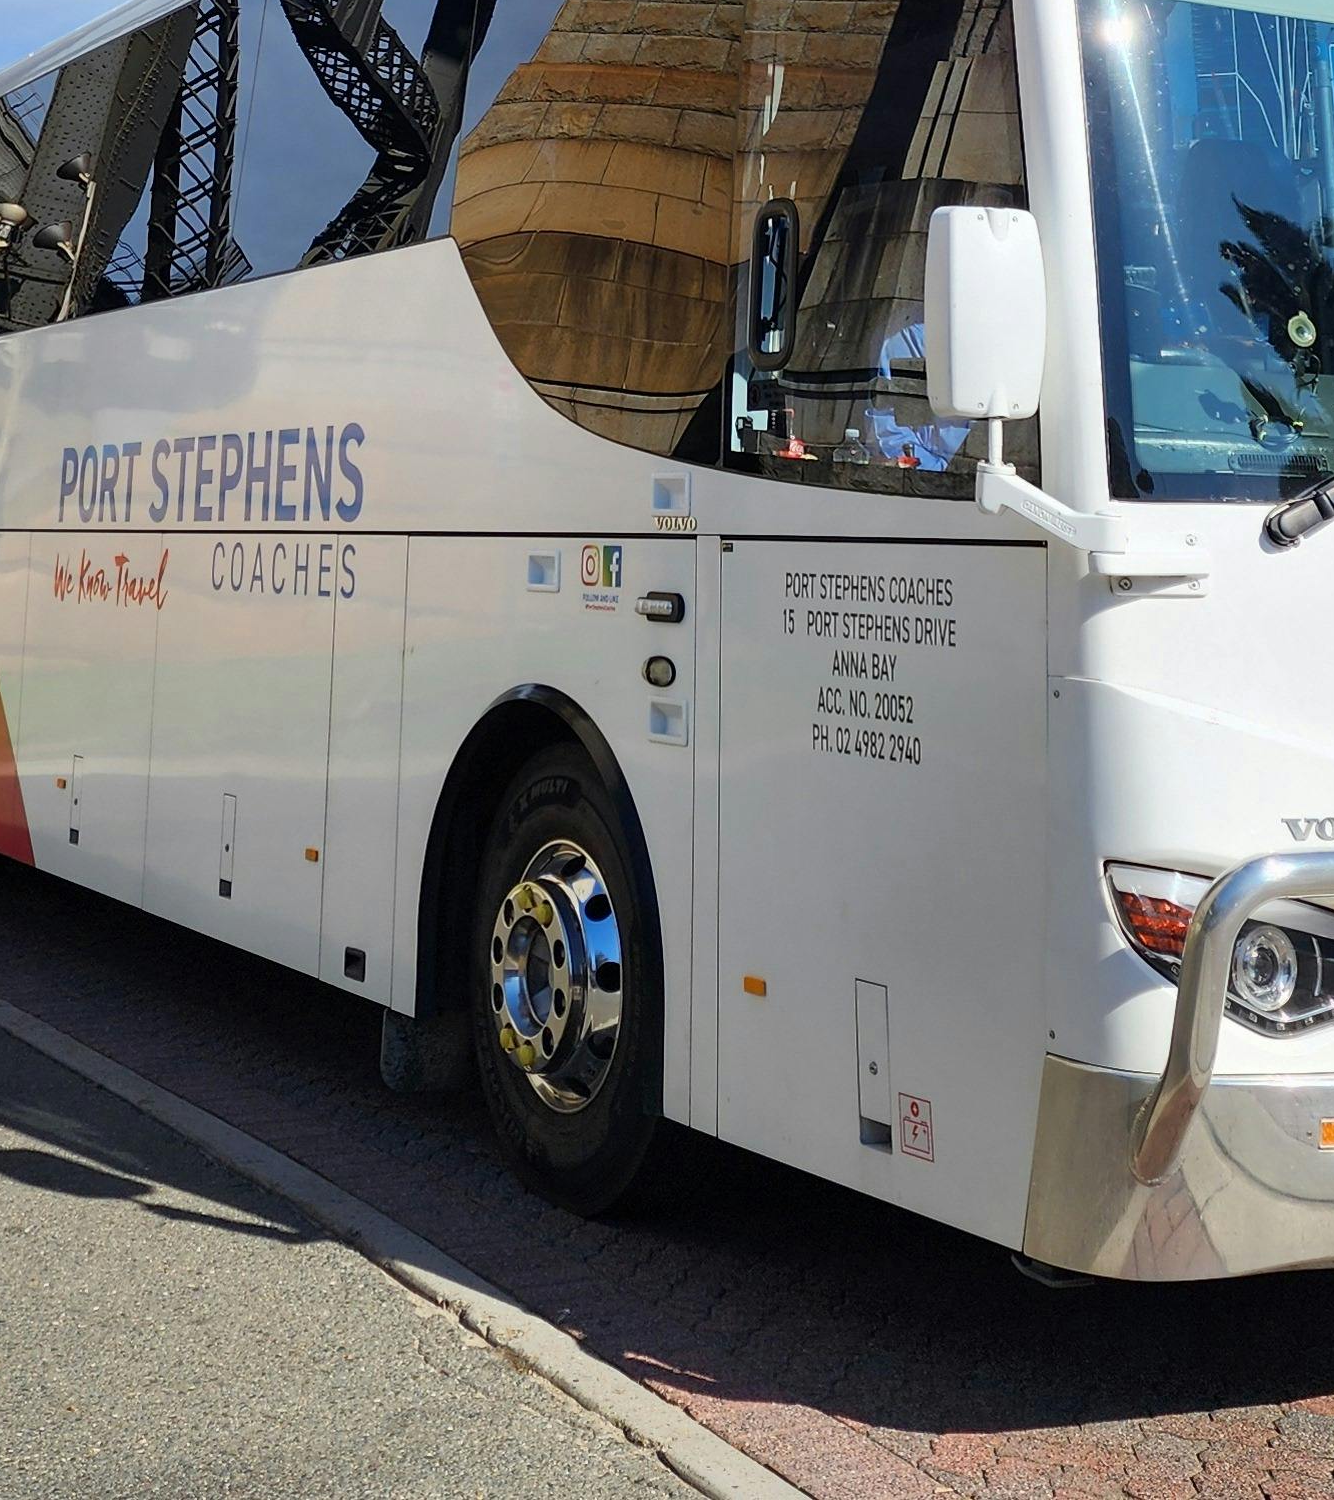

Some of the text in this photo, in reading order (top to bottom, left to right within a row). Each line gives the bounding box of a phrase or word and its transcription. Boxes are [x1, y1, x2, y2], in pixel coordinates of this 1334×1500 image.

[58, 423, 366, 524] PORT STEPHENS
[653, 516, 697, 531] VOLVO
[54, 549, 168, 611] We Know Travel
[211, 542, 357, 598] COACHES
[785, 572, 953, 606] PORT STEPHENS COACHES
[783, 608, 957, 647] 15 PORT STEPHENS DRIVE
[832, 650, 897, 682] ANNA BAY
[817, 686, 914, 724] ACC. NO. 20052
[812, 724, 921, 765] PH. 02 4982 2940
